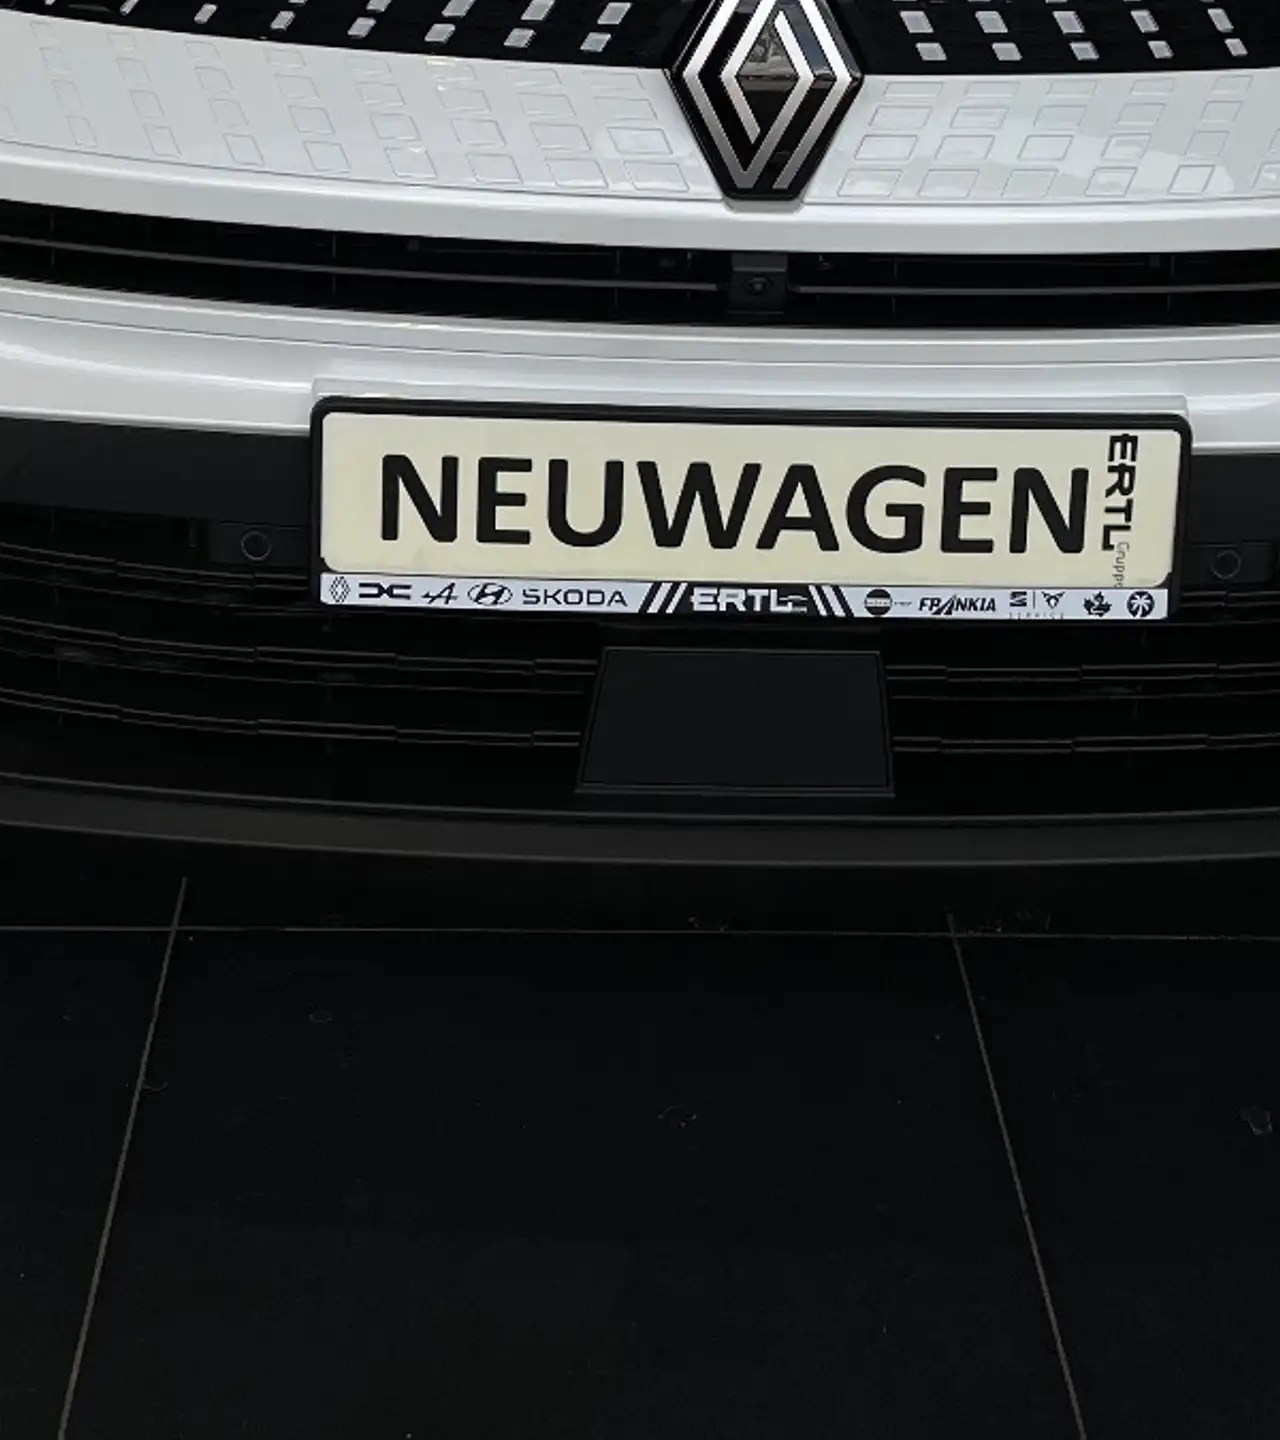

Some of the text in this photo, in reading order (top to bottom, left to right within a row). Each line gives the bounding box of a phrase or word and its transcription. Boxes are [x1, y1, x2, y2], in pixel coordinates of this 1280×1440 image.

[380, 453, 1090, 555] NEUWAGEN
[1101, 433, 1139, 552] ERTL
[690, 585, 798, 613] ERTL
